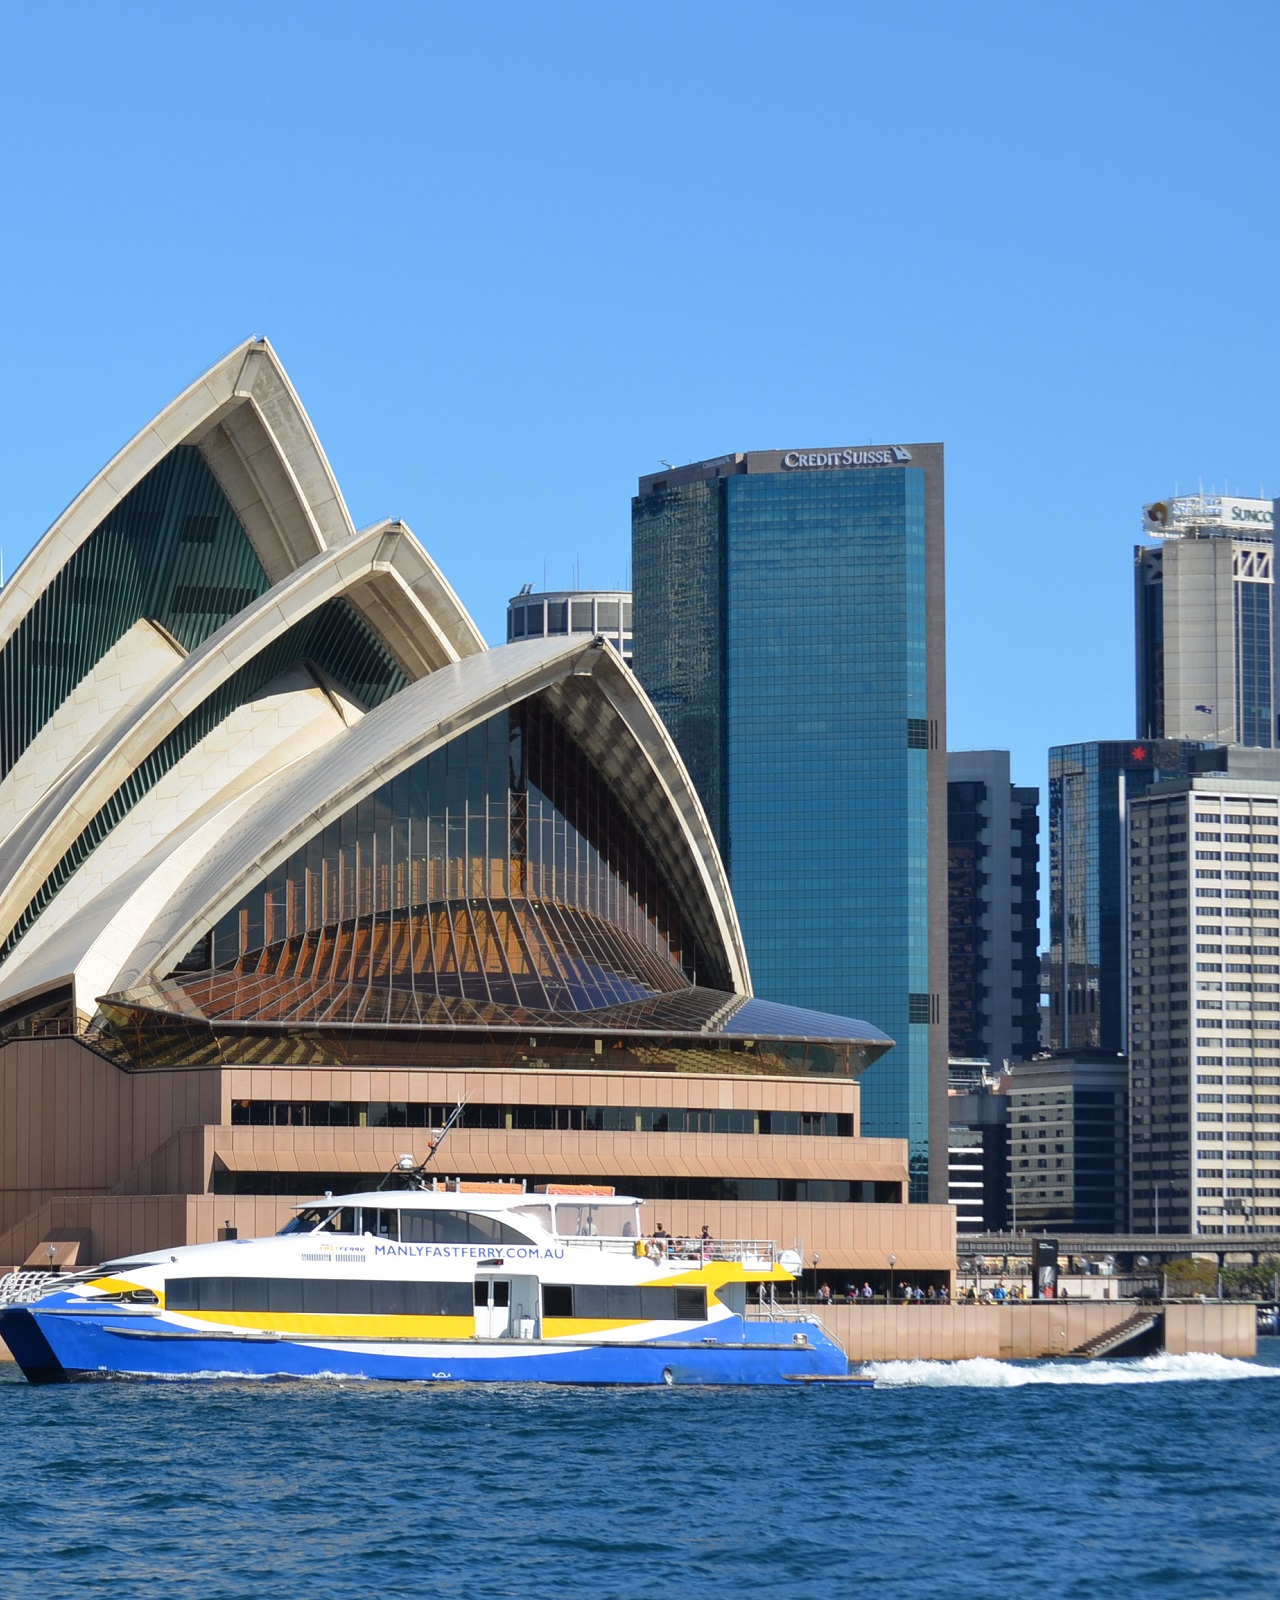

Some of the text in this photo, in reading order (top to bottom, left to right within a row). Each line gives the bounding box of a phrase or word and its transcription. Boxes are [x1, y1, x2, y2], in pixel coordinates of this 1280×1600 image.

[784, 449, 892, 468] CREDIT SUISSE
[374, 1245, 564, 1259] MANLYFASTFERRY.COM.AU
